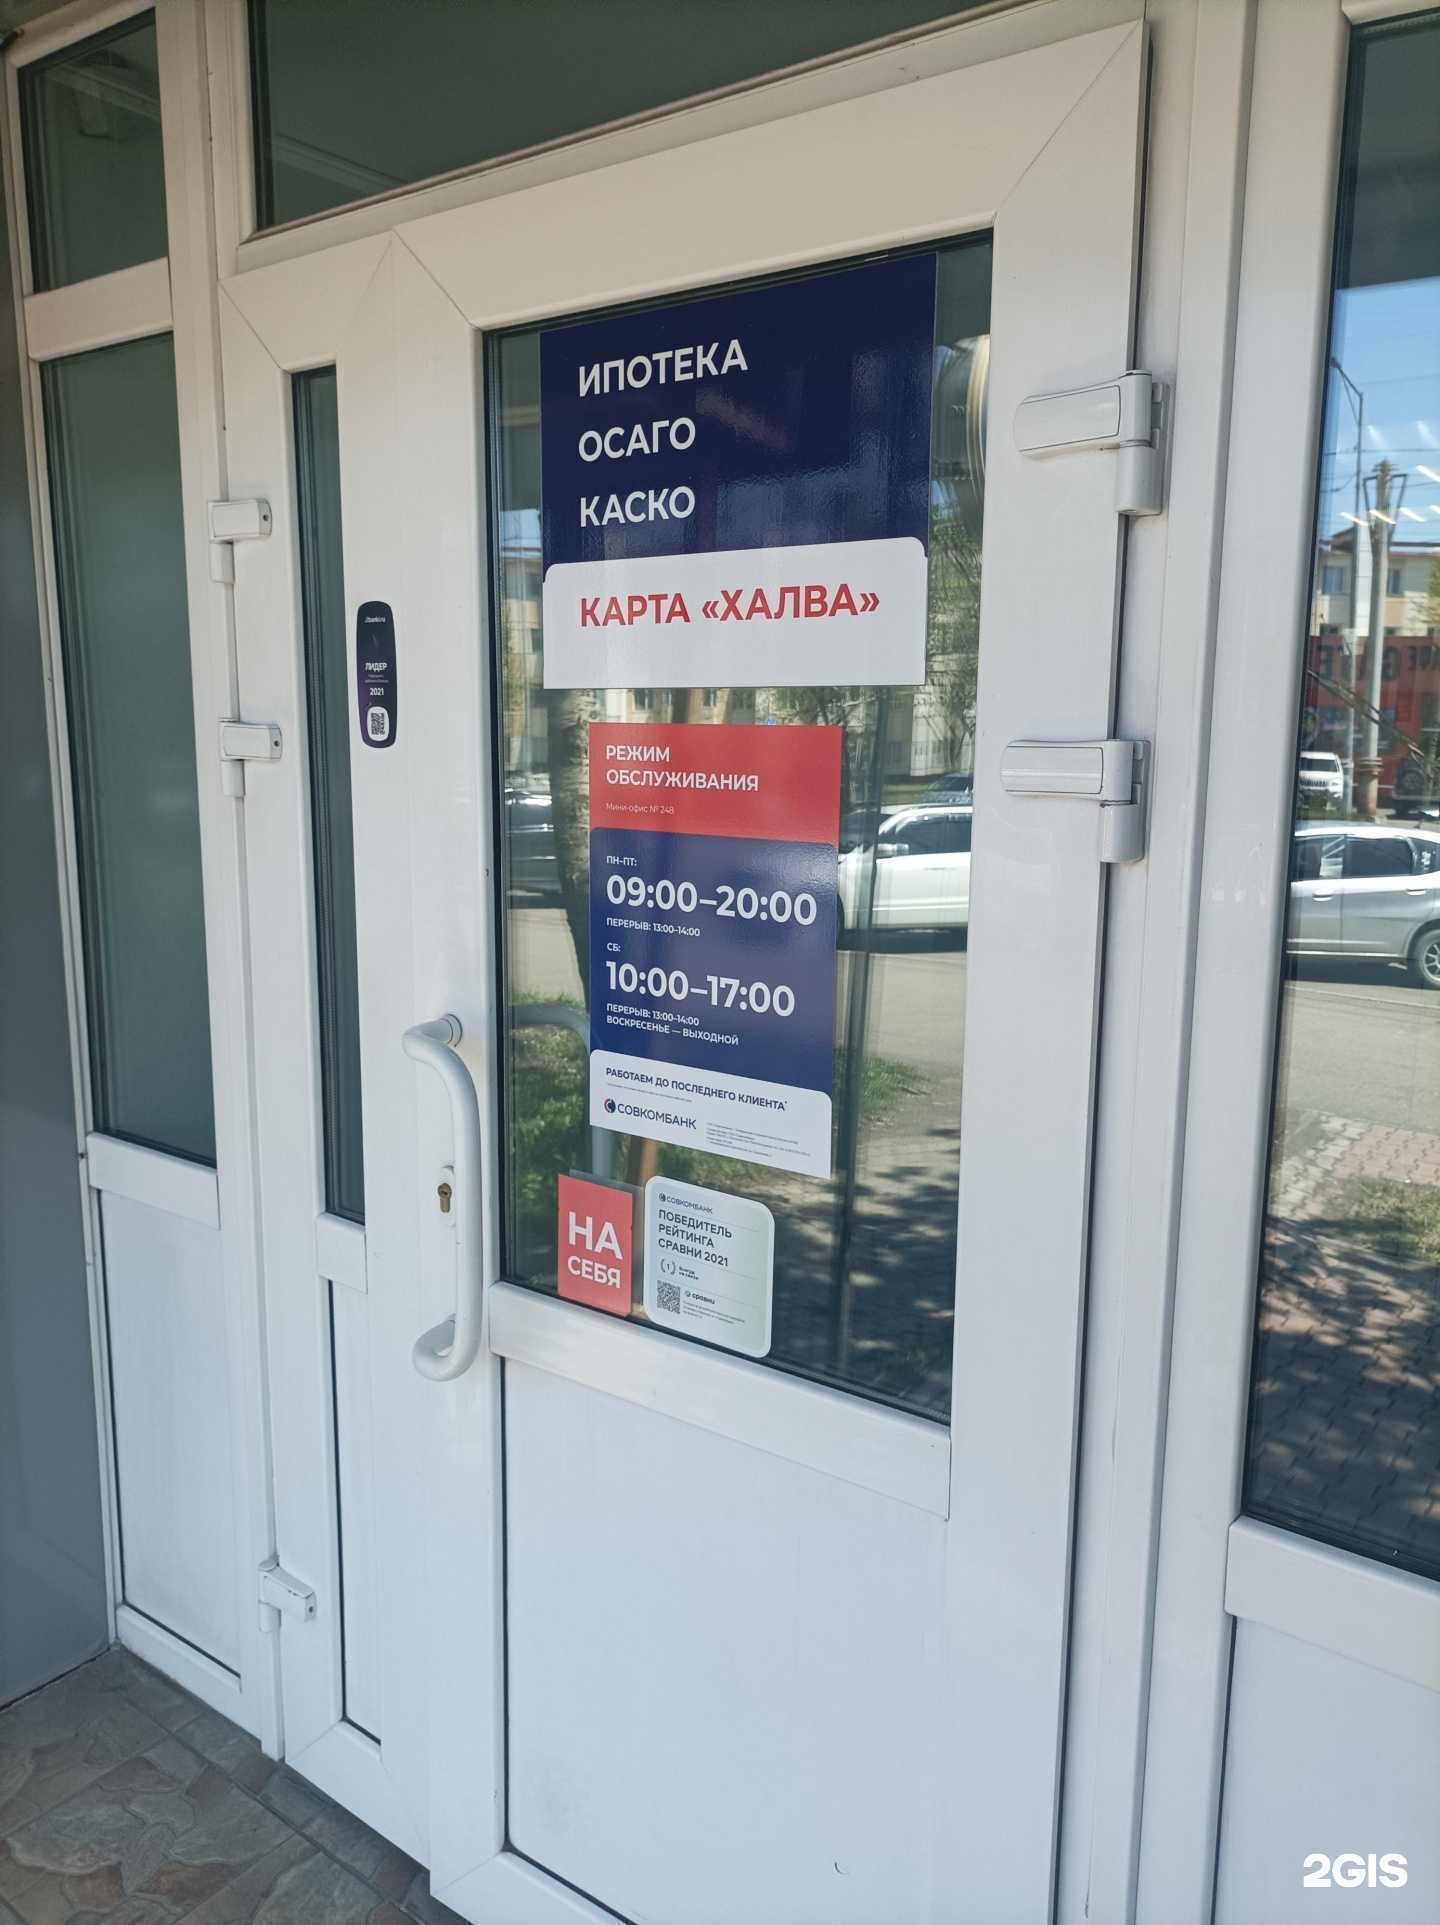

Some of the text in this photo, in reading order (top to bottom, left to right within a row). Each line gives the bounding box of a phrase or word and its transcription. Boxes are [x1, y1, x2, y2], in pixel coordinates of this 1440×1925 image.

[578, 339, 749, 398] ИПОТЕКА
[578, 417, 696, 462] ОСАГО
[580, 486, 696, 528] КАСКО
[580, 583, 880, 628] КАРТА «ХАЛВА»
[365, 662, 388, 672] ЛИДЕР
[370, 687, 385, 696] 2021
[606, 745, 670, 762] РЕЖИМ
[606, 769, 759, 792] ОБСЛУЖИВАНИЯ
[606, 856, 638, 867] ПН-ПТ:
[606, 874, 817, 926] 09:00–20:00
[606, 917, 651, 932] ПЕРЕРЫВ:
[606, 942, 621, 953] СБ:
[606, 961, 795, 1017] 10:00–17:00
[606, 1003, 651, 1018] ПЕРЕРЫВ:
[606, 1015, 670, 1034] ВОСКРЕСЕНЬЕ
[682, 1028, 739, 1046] ВЫХОДНОЙ
[606, 1067, 654, 1085] РАБОТАЕМ
[655, 1077, 670, 1089] ДО
[671, 1080, 736, 1102] ПОСЛЕДНЕГО
[617, 1103, 697, 1130] СОВКОМБАНК
[567, 1211, 624, 1260] НА
[658, 1209, 733, 1239] ПОБЕДИТЕЛЬ
[658, 1223, 715, 1248] РЕЙТИНГА
[658, 1238, 729, 1267] СРАВНИ 2021
[567, 1256, 621, 1289] СЕБЯ
